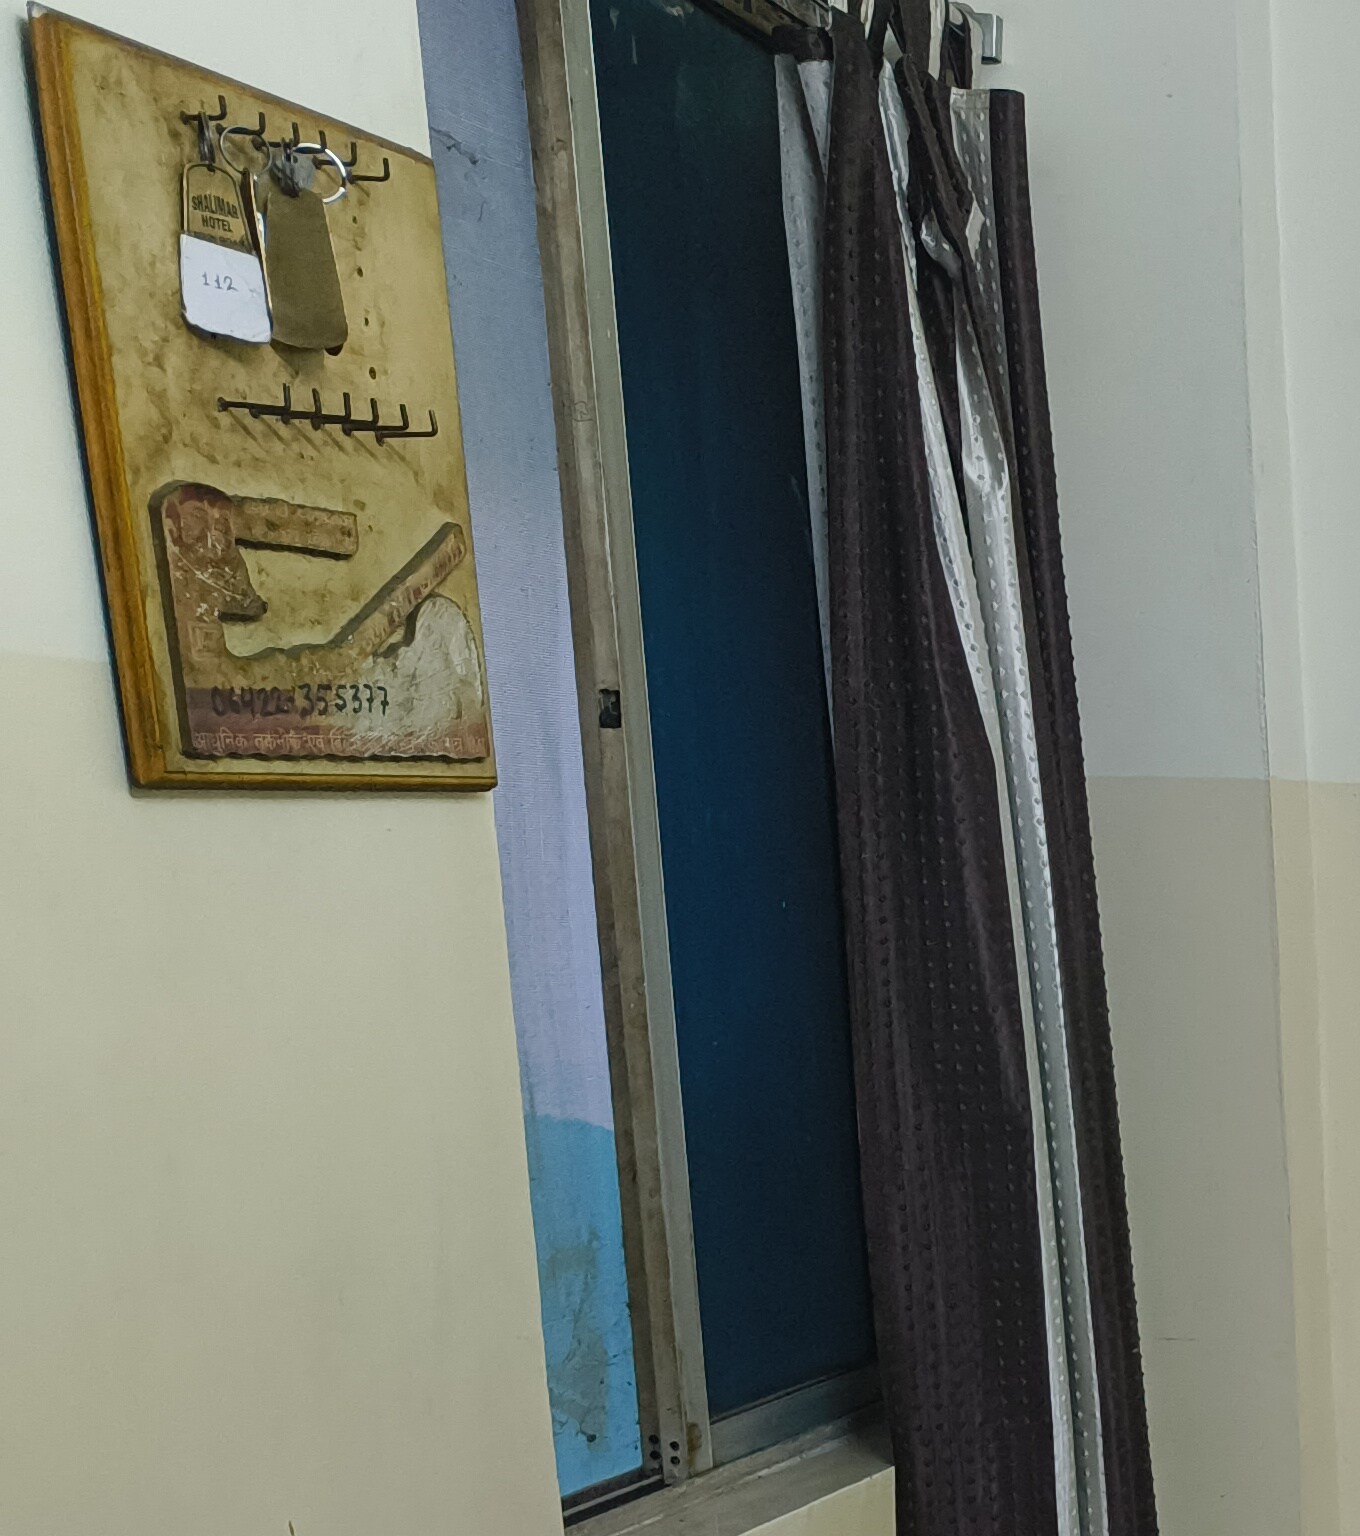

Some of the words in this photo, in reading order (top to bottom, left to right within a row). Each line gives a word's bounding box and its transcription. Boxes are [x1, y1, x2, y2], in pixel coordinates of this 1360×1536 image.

[191, 193, 239, 219] SHALIMAR
[201, 213, 233, 233] HOTEL
[201, 271, 239, 291] 112
